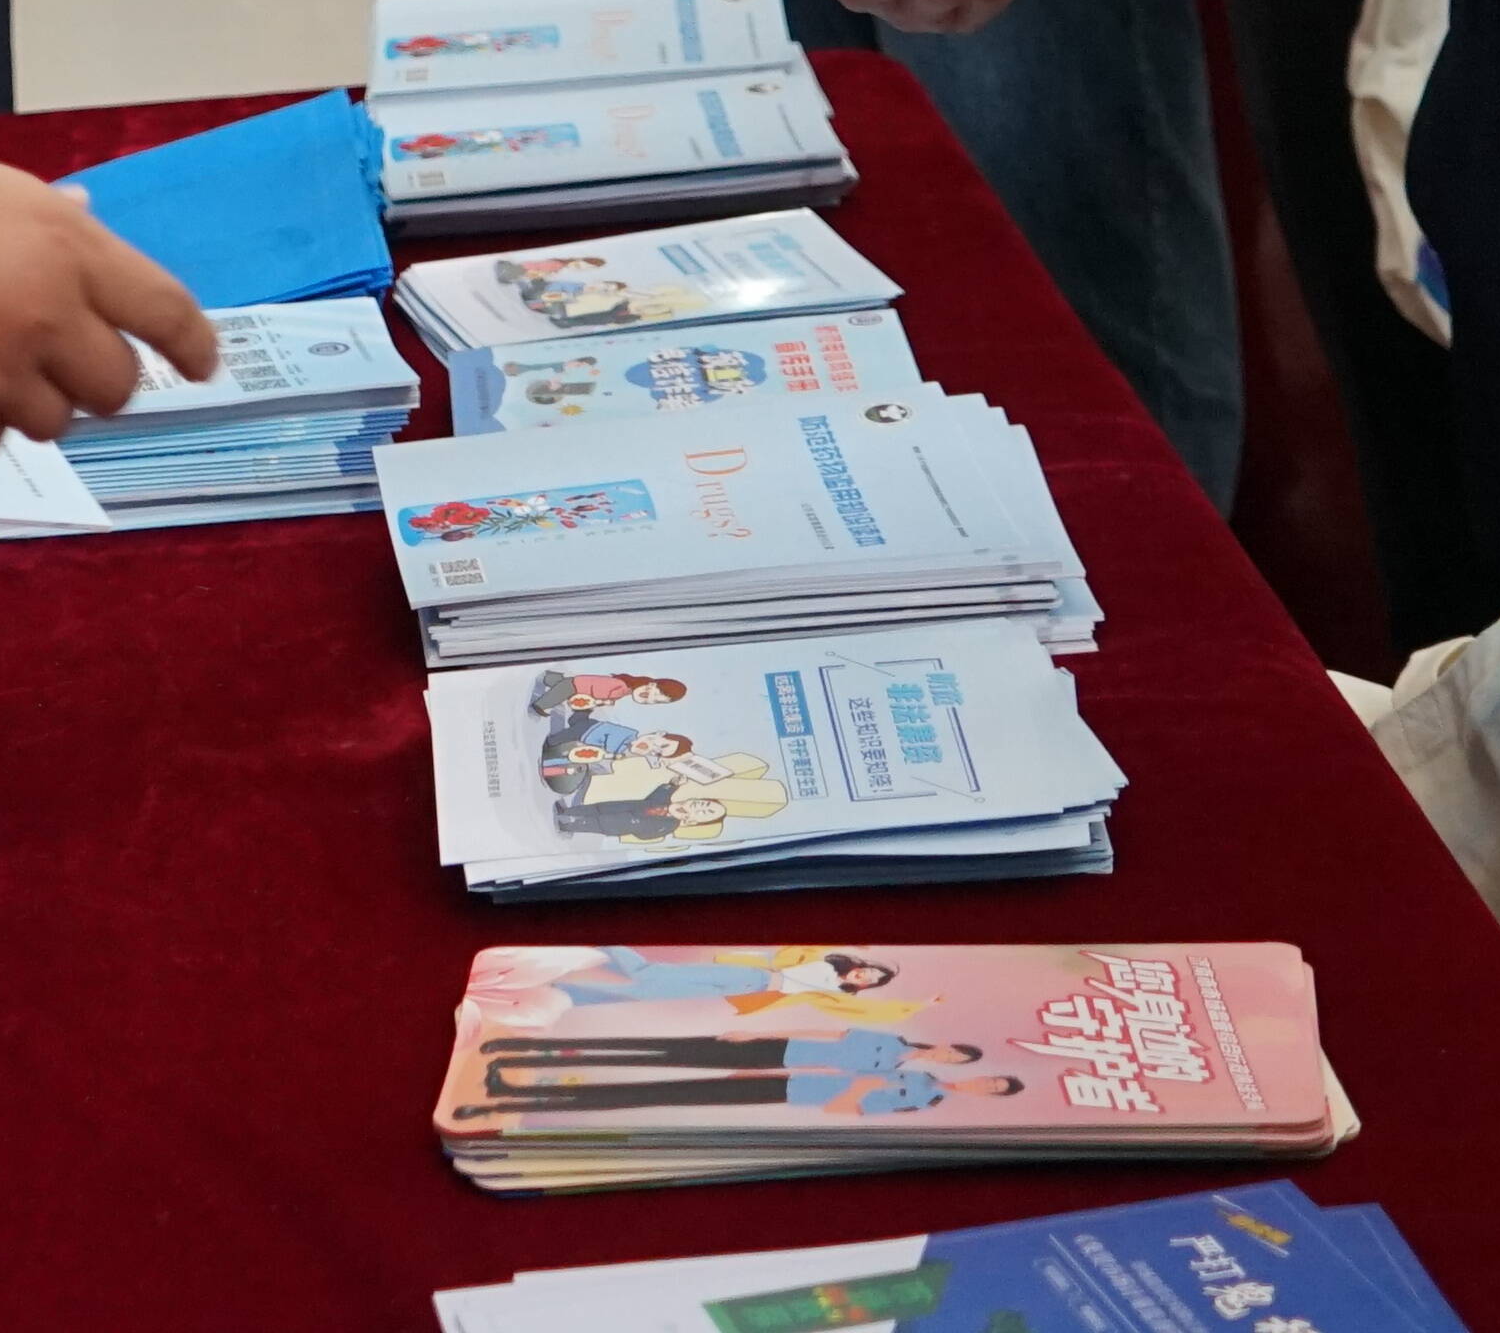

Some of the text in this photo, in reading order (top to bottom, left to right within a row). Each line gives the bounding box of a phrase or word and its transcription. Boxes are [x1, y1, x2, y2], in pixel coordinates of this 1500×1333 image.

[1006, 994, 1166, 1114] 守护者
[1077, 949, 1215, 1084] 您身边的
